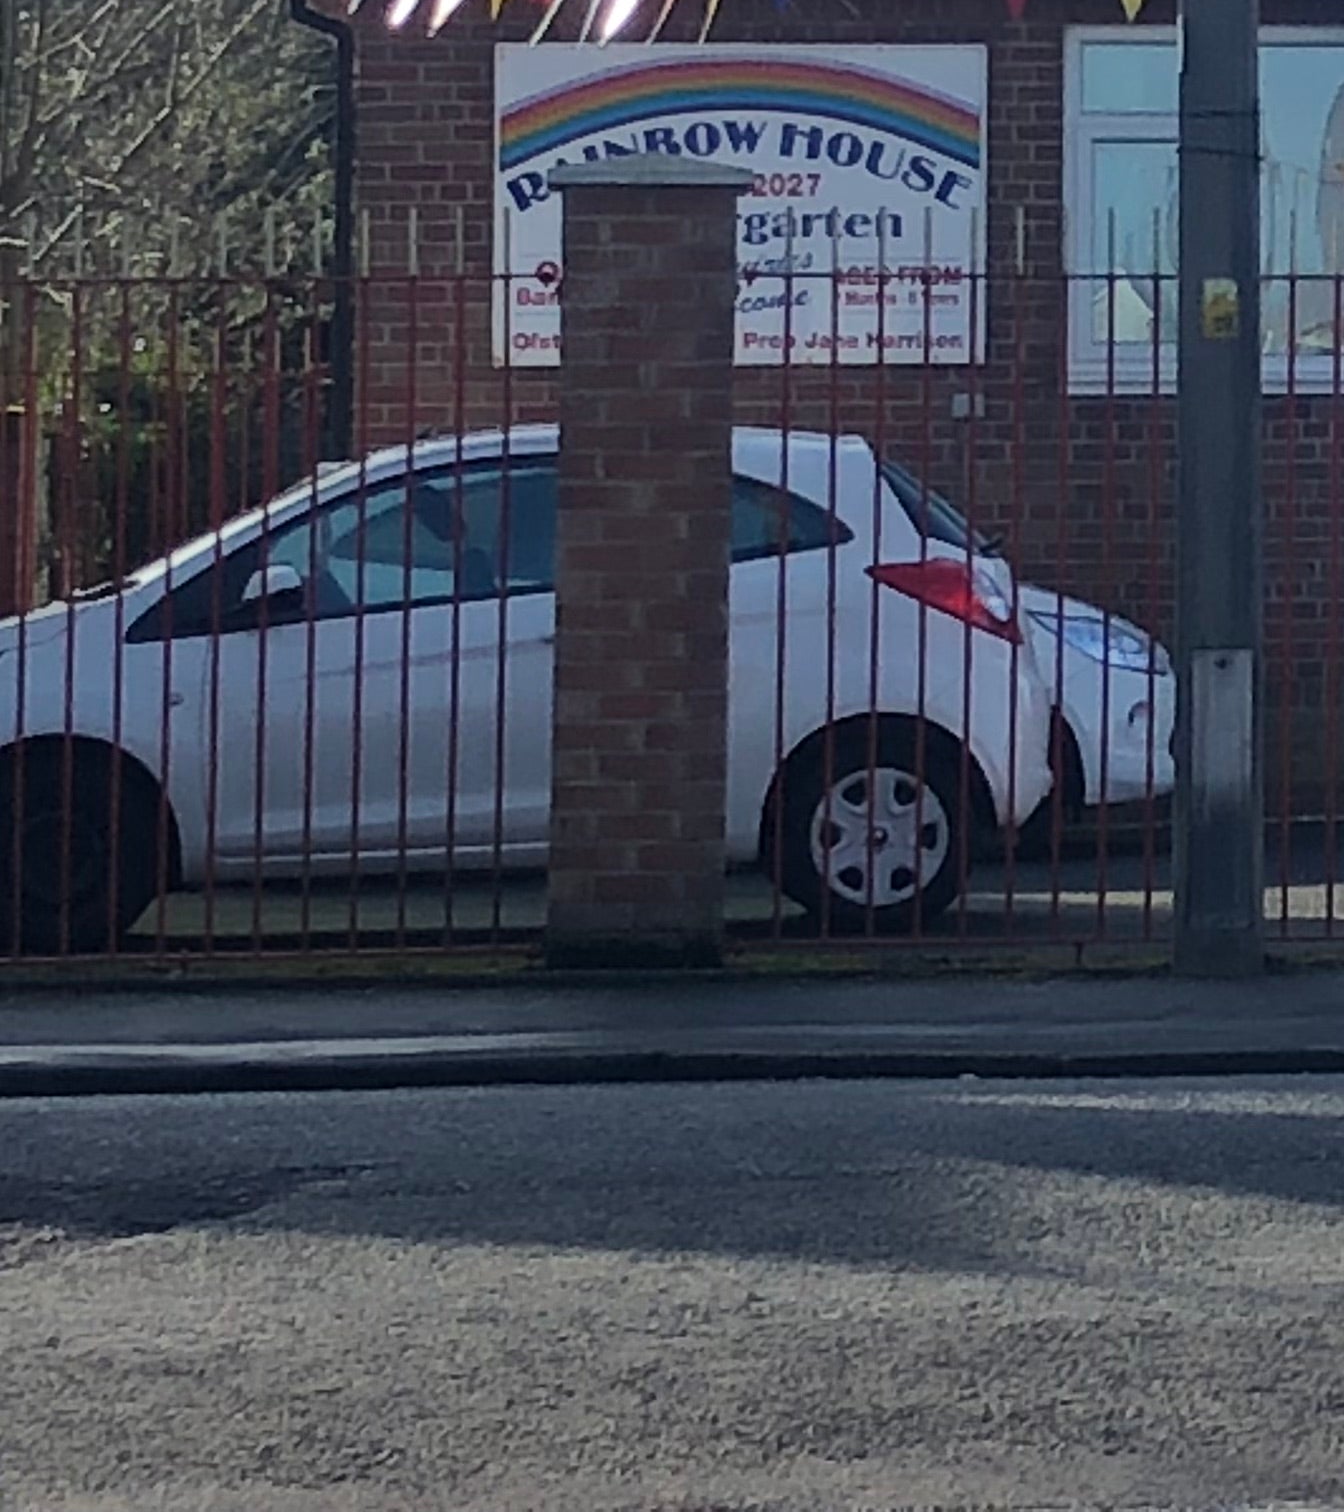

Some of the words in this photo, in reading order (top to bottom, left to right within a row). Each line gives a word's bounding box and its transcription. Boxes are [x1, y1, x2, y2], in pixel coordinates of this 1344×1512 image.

[779, 122, 973, 210] HOUSE
[752, 173, 822, 197] 2027
[512, 332, 561, 351] Ofst
